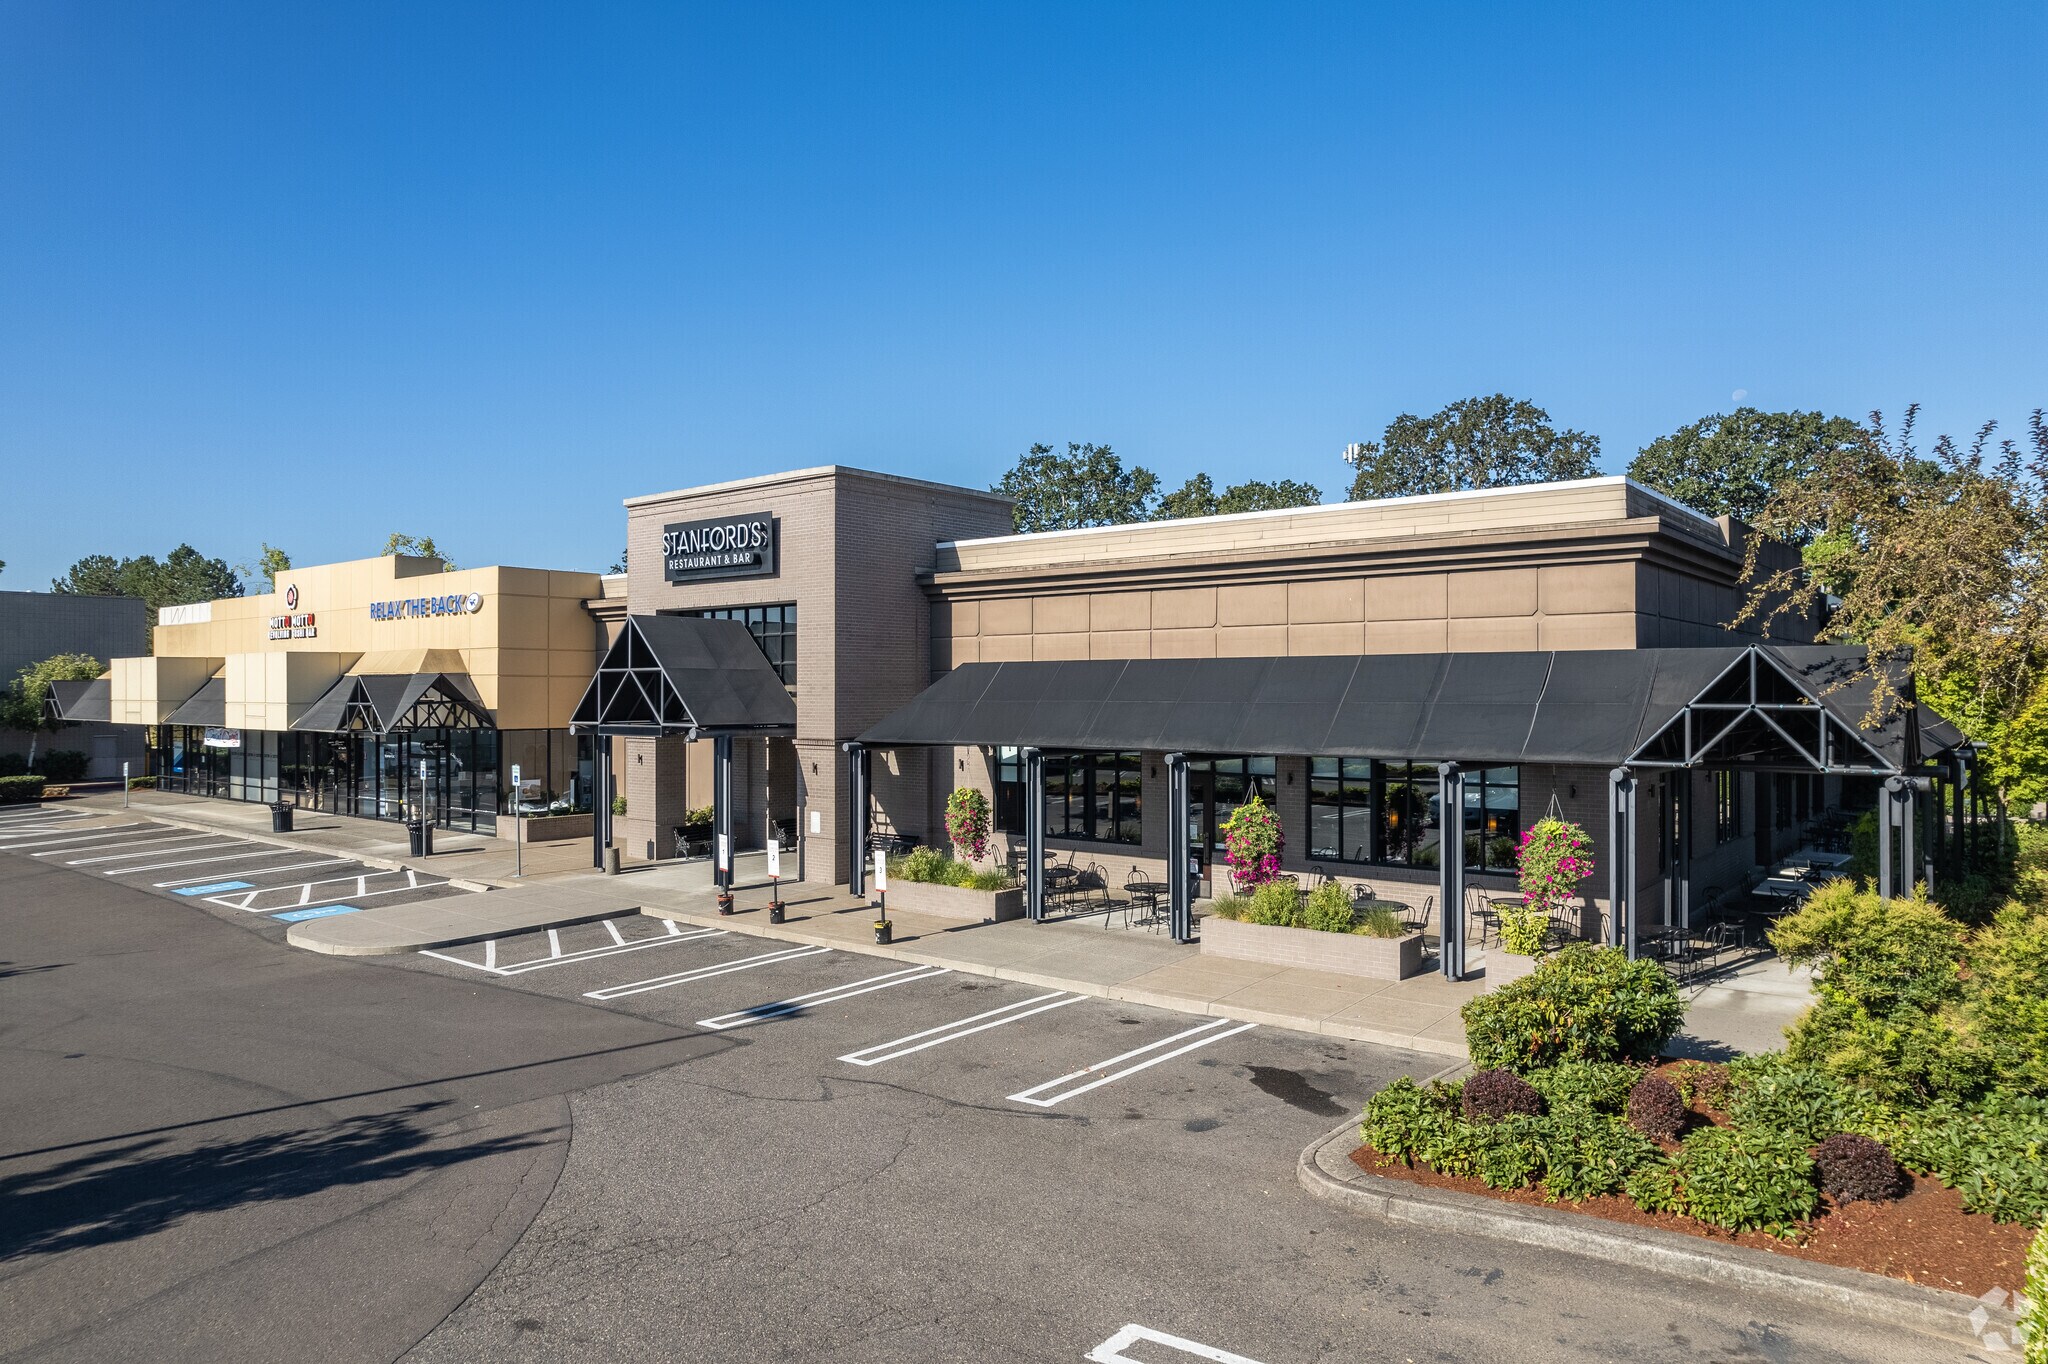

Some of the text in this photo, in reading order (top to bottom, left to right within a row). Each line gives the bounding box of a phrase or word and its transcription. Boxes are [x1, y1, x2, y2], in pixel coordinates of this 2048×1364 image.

[662, 521, 761, 556] STANFORD'S
[669, 552, 751, 570] RESTAURANT & BAR
[370, 595, 463, 619] RELAX THE BACK
